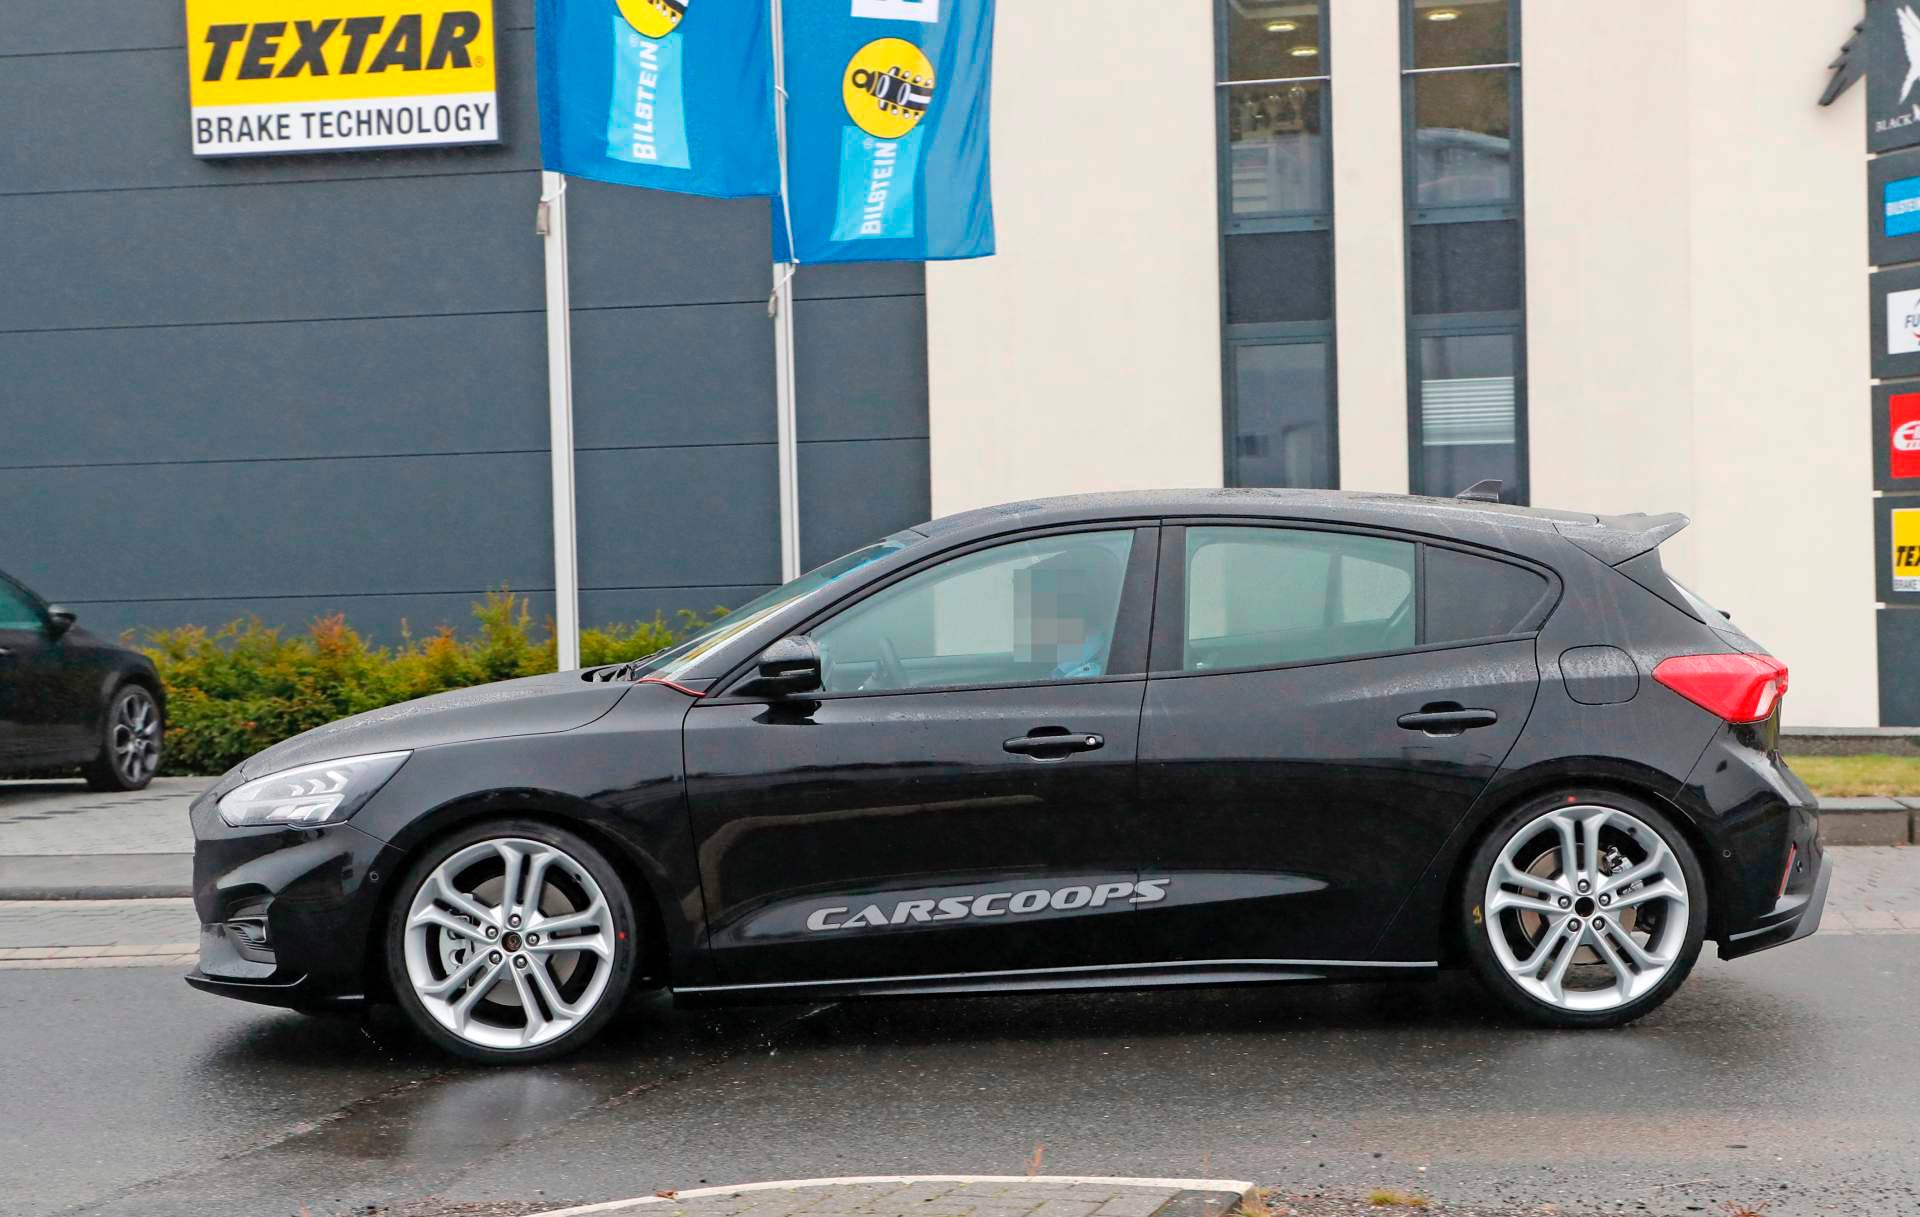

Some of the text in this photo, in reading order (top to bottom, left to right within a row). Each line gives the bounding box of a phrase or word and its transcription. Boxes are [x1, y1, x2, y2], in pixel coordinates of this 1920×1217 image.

[196, 103, 490, 144] BRAKE TECHNOLOGY
[632, 41, 659, 160] BILSTEIN
[859, 142, 897, 235] BILSTEIN
